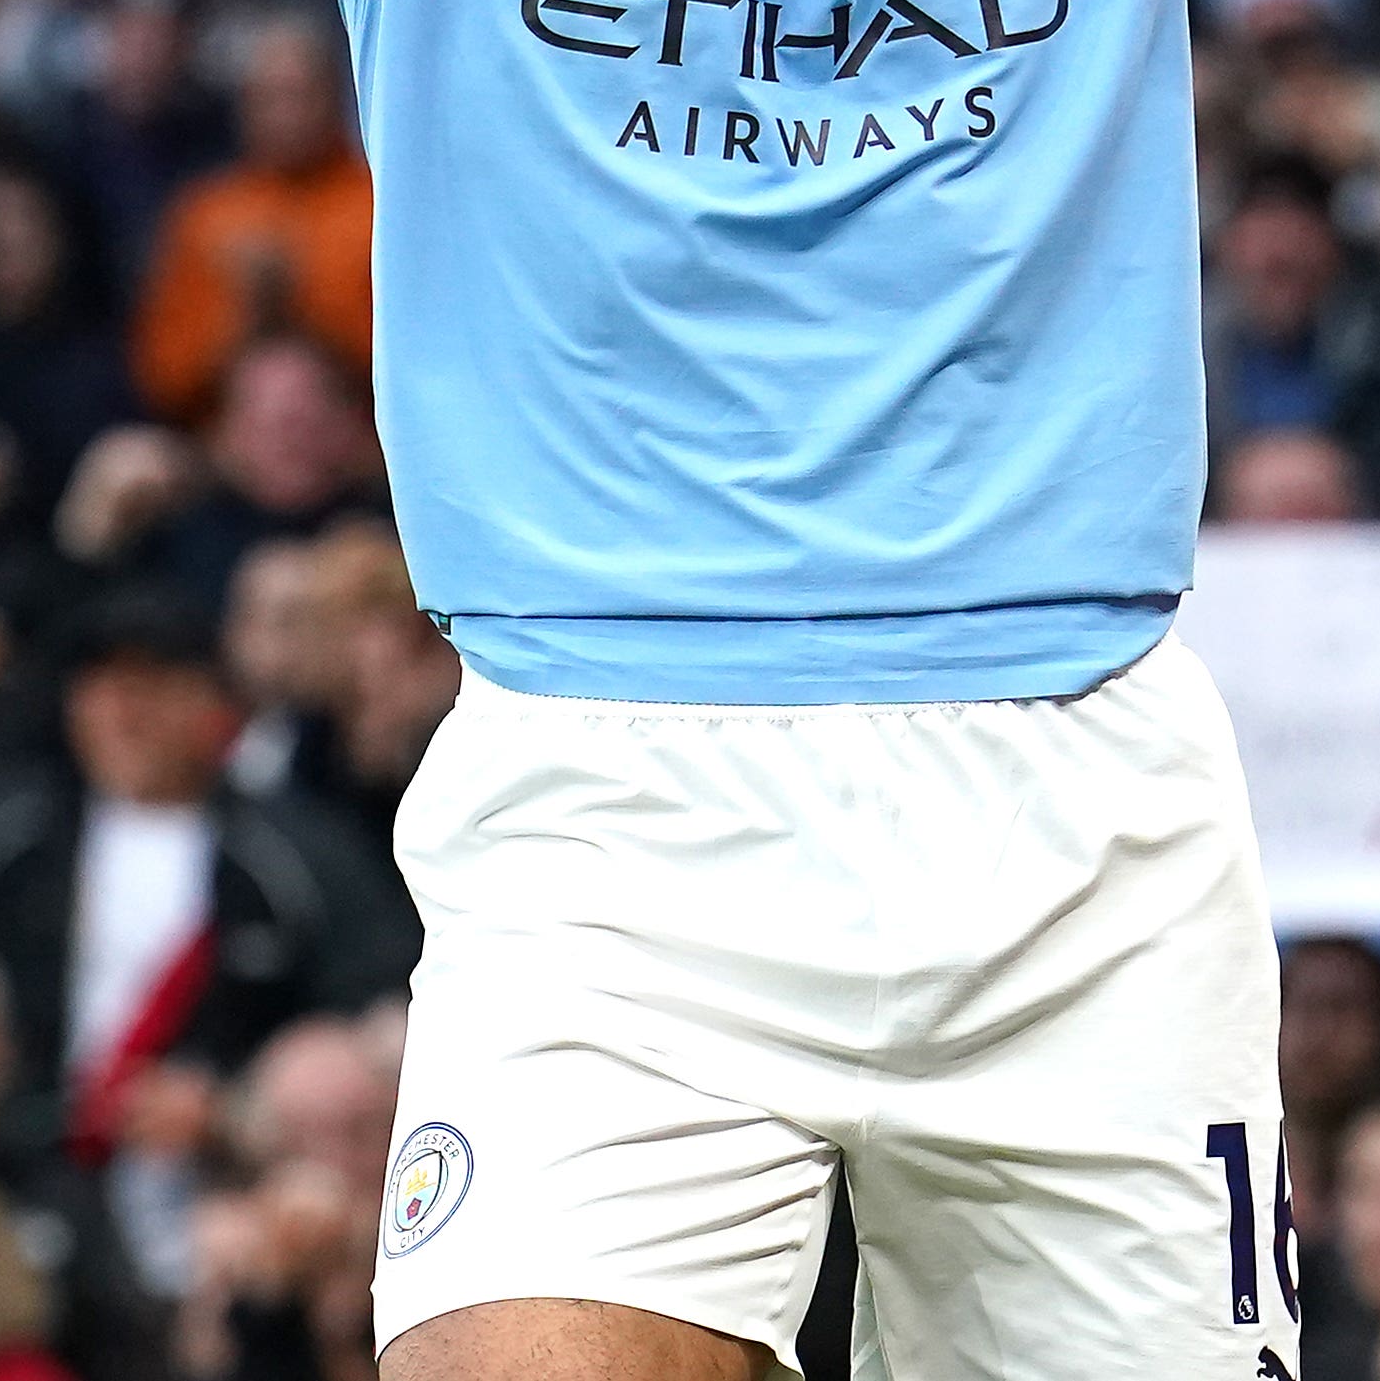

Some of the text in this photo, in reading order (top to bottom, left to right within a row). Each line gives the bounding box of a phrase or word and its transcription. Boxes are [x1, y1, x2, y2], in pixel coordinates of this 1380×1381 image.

[615, 87, 996, 167] AIRWAYS
[389, 1133, 460, 1193] NHESTER
[400, 1226, 426, 1249] CITY
